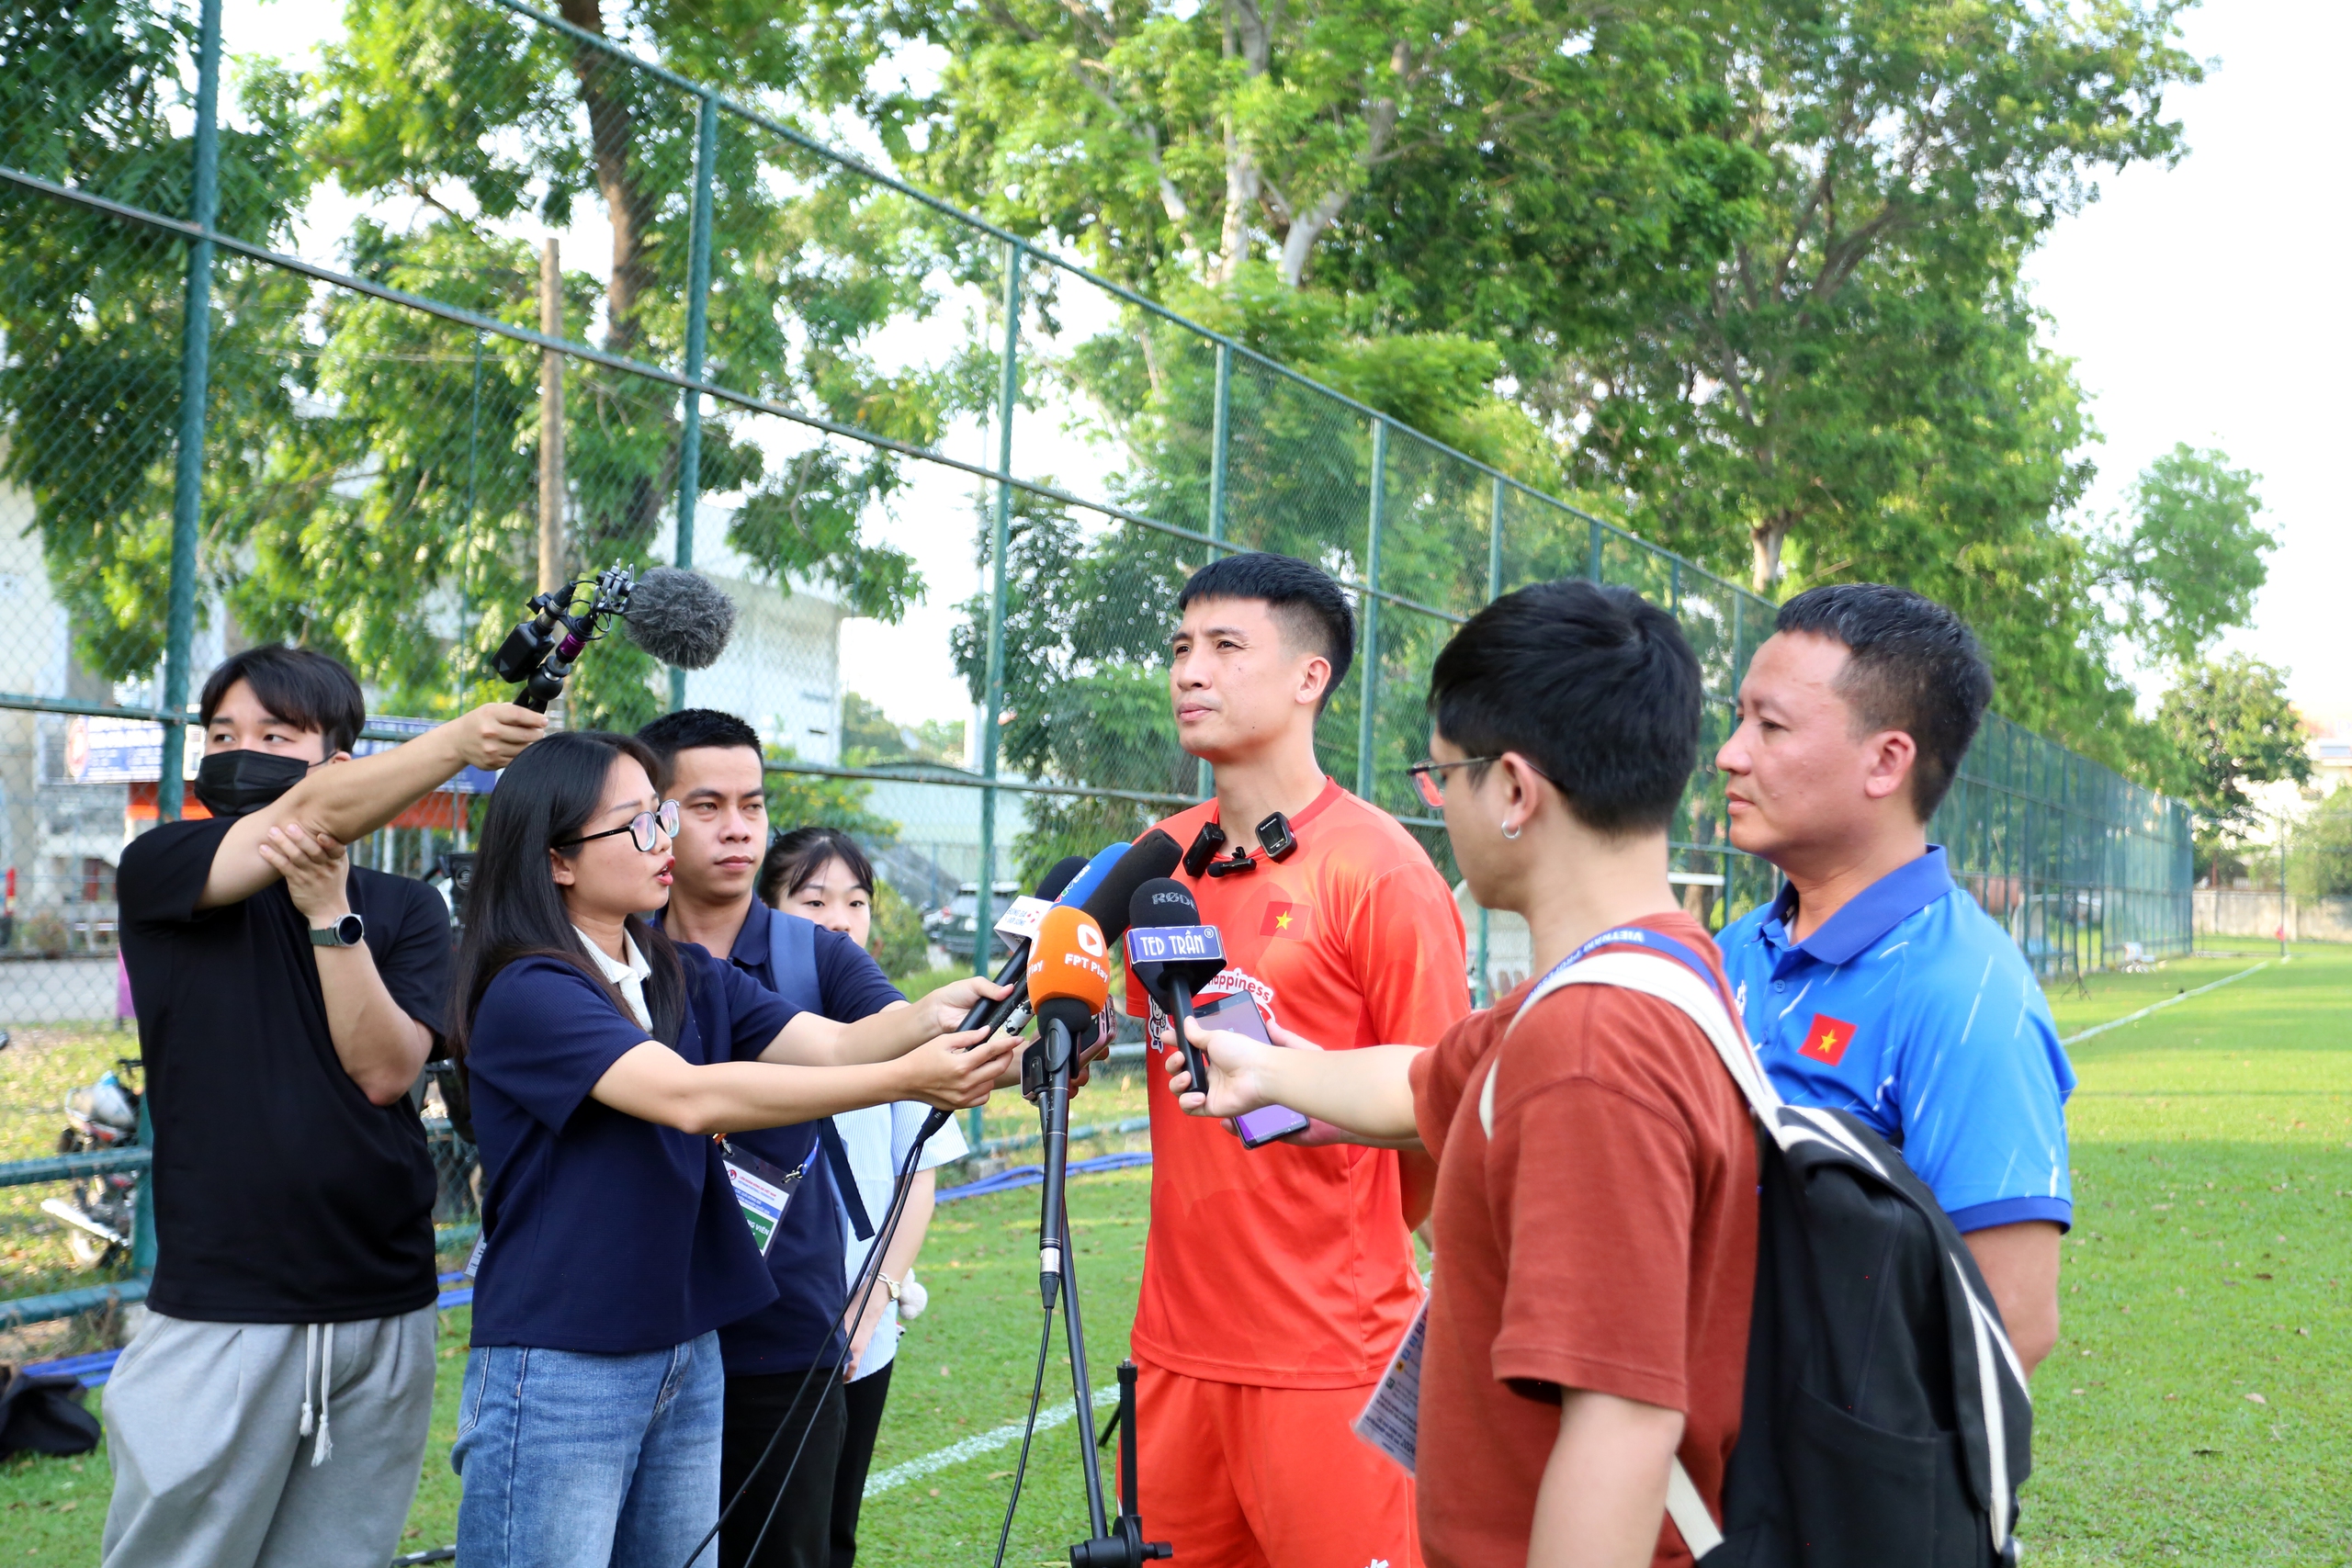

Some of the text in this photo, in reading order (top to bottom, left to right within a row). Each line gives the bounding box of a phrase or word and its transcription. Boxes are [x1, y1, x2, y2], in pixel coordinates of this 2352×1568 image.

[1139, 936, 1165, 956] TED
[1168, 929, 1205, 955] TRẦN
[1583, 930, 1644, 952] VIETNAM
[1064, 953, 1109, 984] FPT Play
